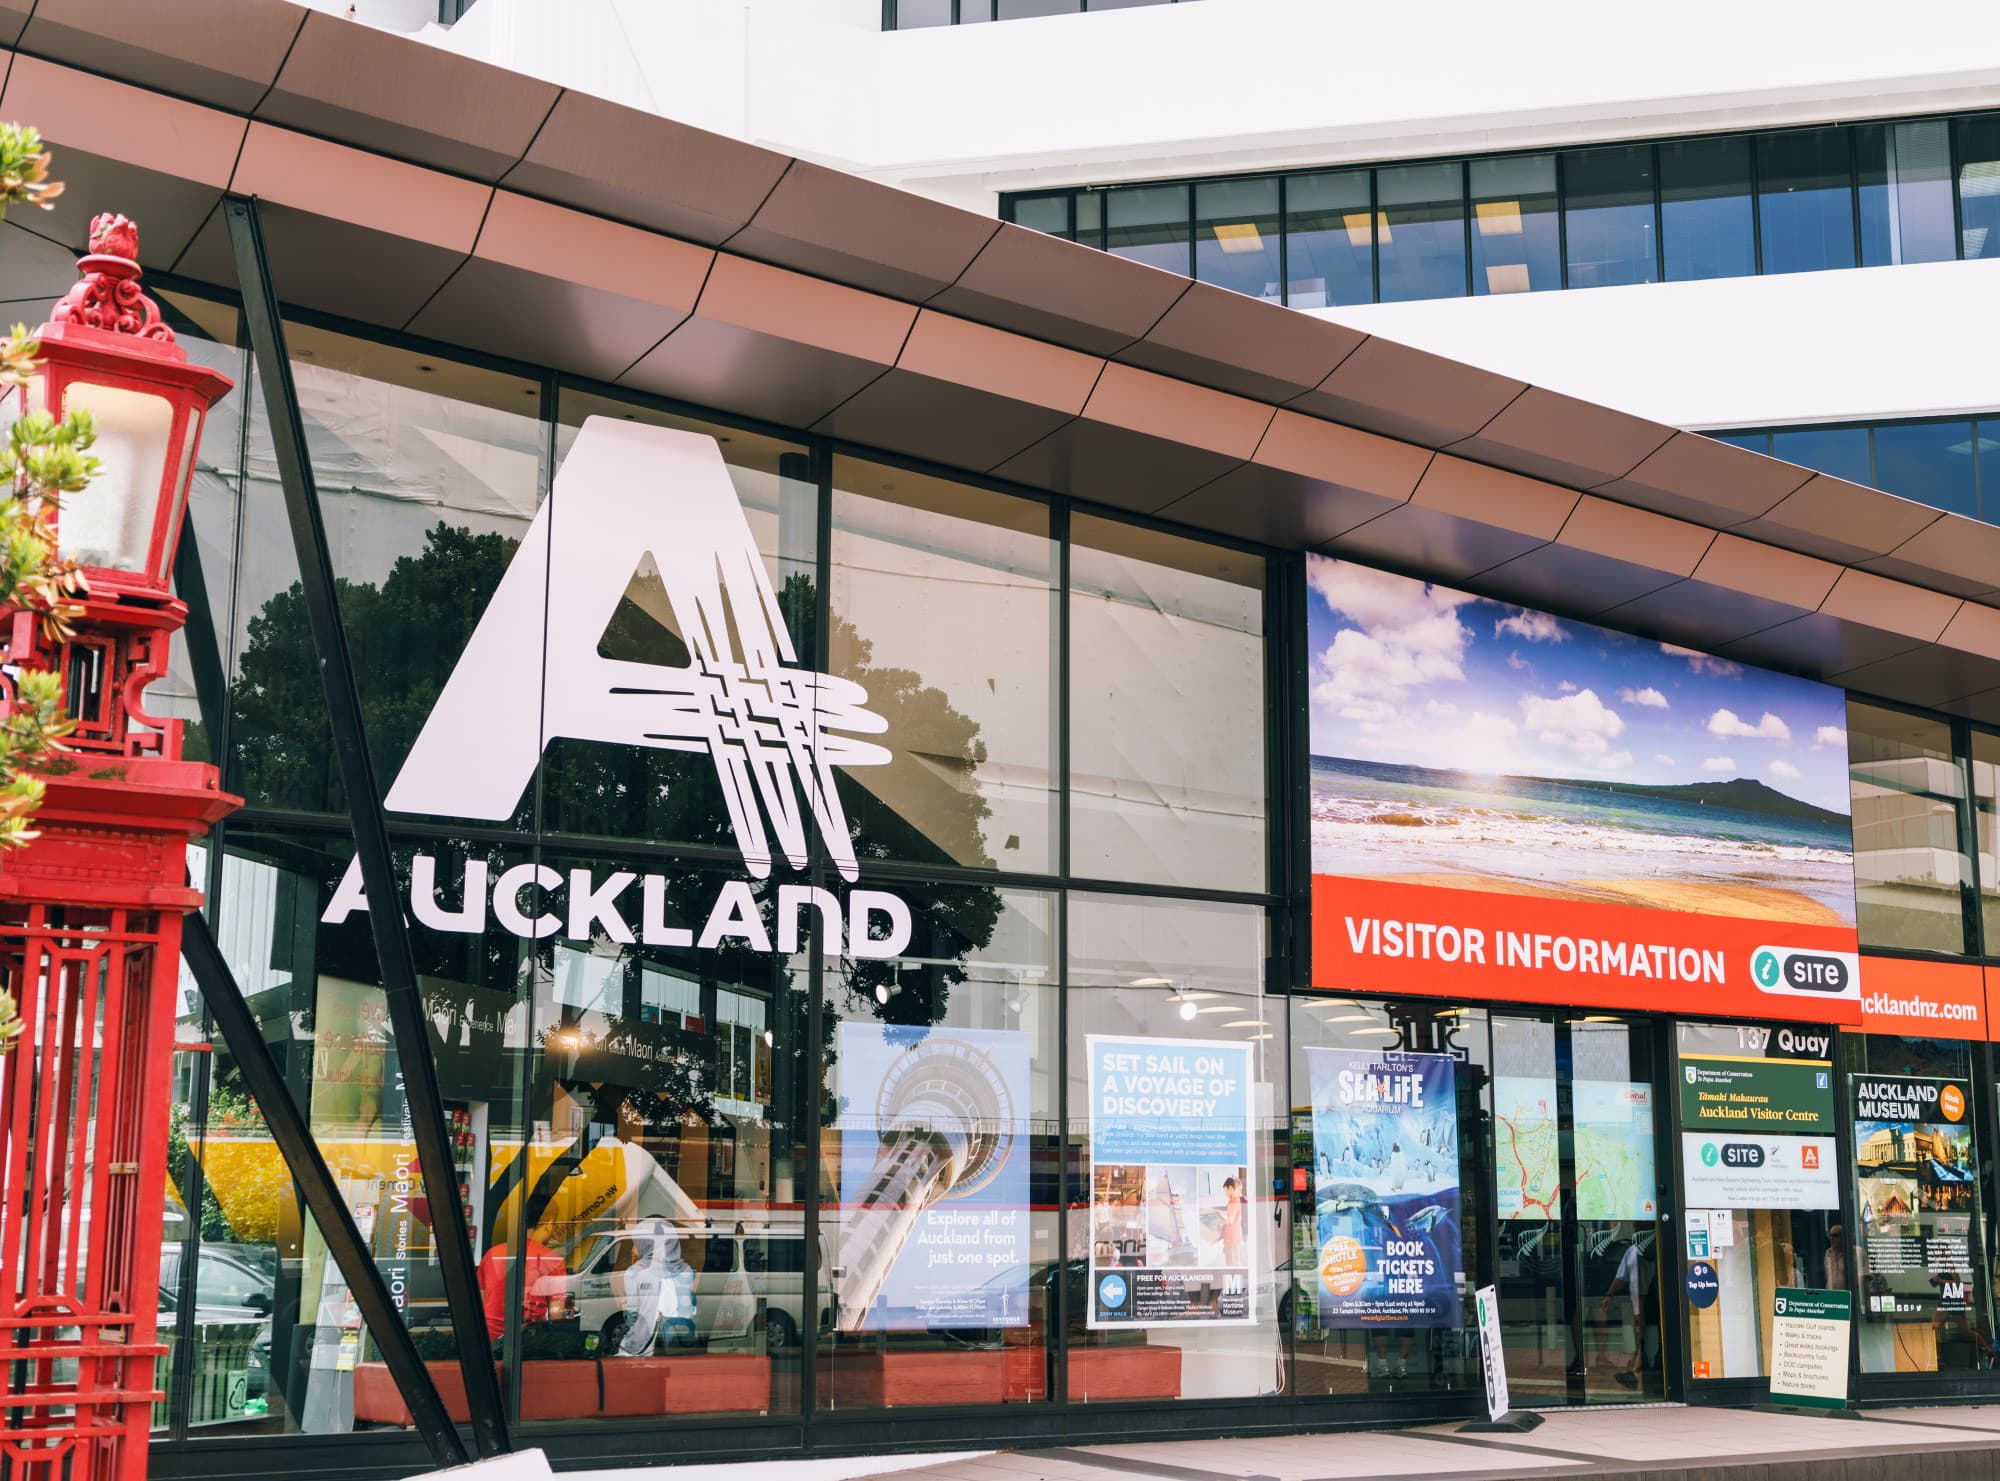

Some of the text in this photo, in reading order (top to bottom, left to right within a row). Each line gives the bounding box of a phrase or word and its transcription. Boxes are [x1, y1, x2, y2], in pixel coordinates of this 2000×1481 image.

[1344, 916, 1726, 985] VISITOR INFORMATION
[1736, 1026, 1830, 1058] 137 Quay
[1103, 1053, 1225, 1076] SET SAIL ON
[1349, 1061, 1414, 1073] KELLY TARLTON'S
[1103, 1074, 1237, 1097] A VOYAGE OF
[1338, 1070, 1379, 1103] SEA
[1858, 1082, 1939, 1102] AUCKLAND
[1944, 1091, 1960, 1104] Book
[1103, 1096, 1217, 1118] DISCOVERY
[1361, 1104, 1402, 1115] AQUARIUM
[1699, 1105, 1819, 1122] Auckland Visitor Centre
[1858, 1100, 1920, 1120] MUSEUM
[1944, 1102, 1959, 1114] Here
[391, 1154, 409, 1213] Maori
[927, 1210, 1017, 1230] Explore all of
[396, 1219, 407, 1260] Stories
[917, 1229, 1016, 1245] Auckland from
[1386, 1240, 1424, 1256] BOOK
[927, 1251, 1020, 1268] just one spot.
[1376, 1259, 1435, 1276] TICKETS
[1136, 1274, 1214, 1283] FREE FOR AUCKLANDERS
[1388, 1279, 1424, 1294] HERE
[1698, 1281, 1706, 1289] Up
[388, 1267, 406, 1312] aori
[1942, 1282, 1965, 1300] AM
[1788, 1299, 1814, 1308] Department
[1820, 1301, 1849, 1309] Conservation
[1805, 1322, 1817, 1330] Gulf
[1784, 1341, 1799, 1349] Great
[1815, 1344, 1839, 1353] bookings
[1783, 1371, 1797, 1379] Maps
[1803, 1373, 1829, 1381] brochures
[1800, 1382, 1816, 1390] books
